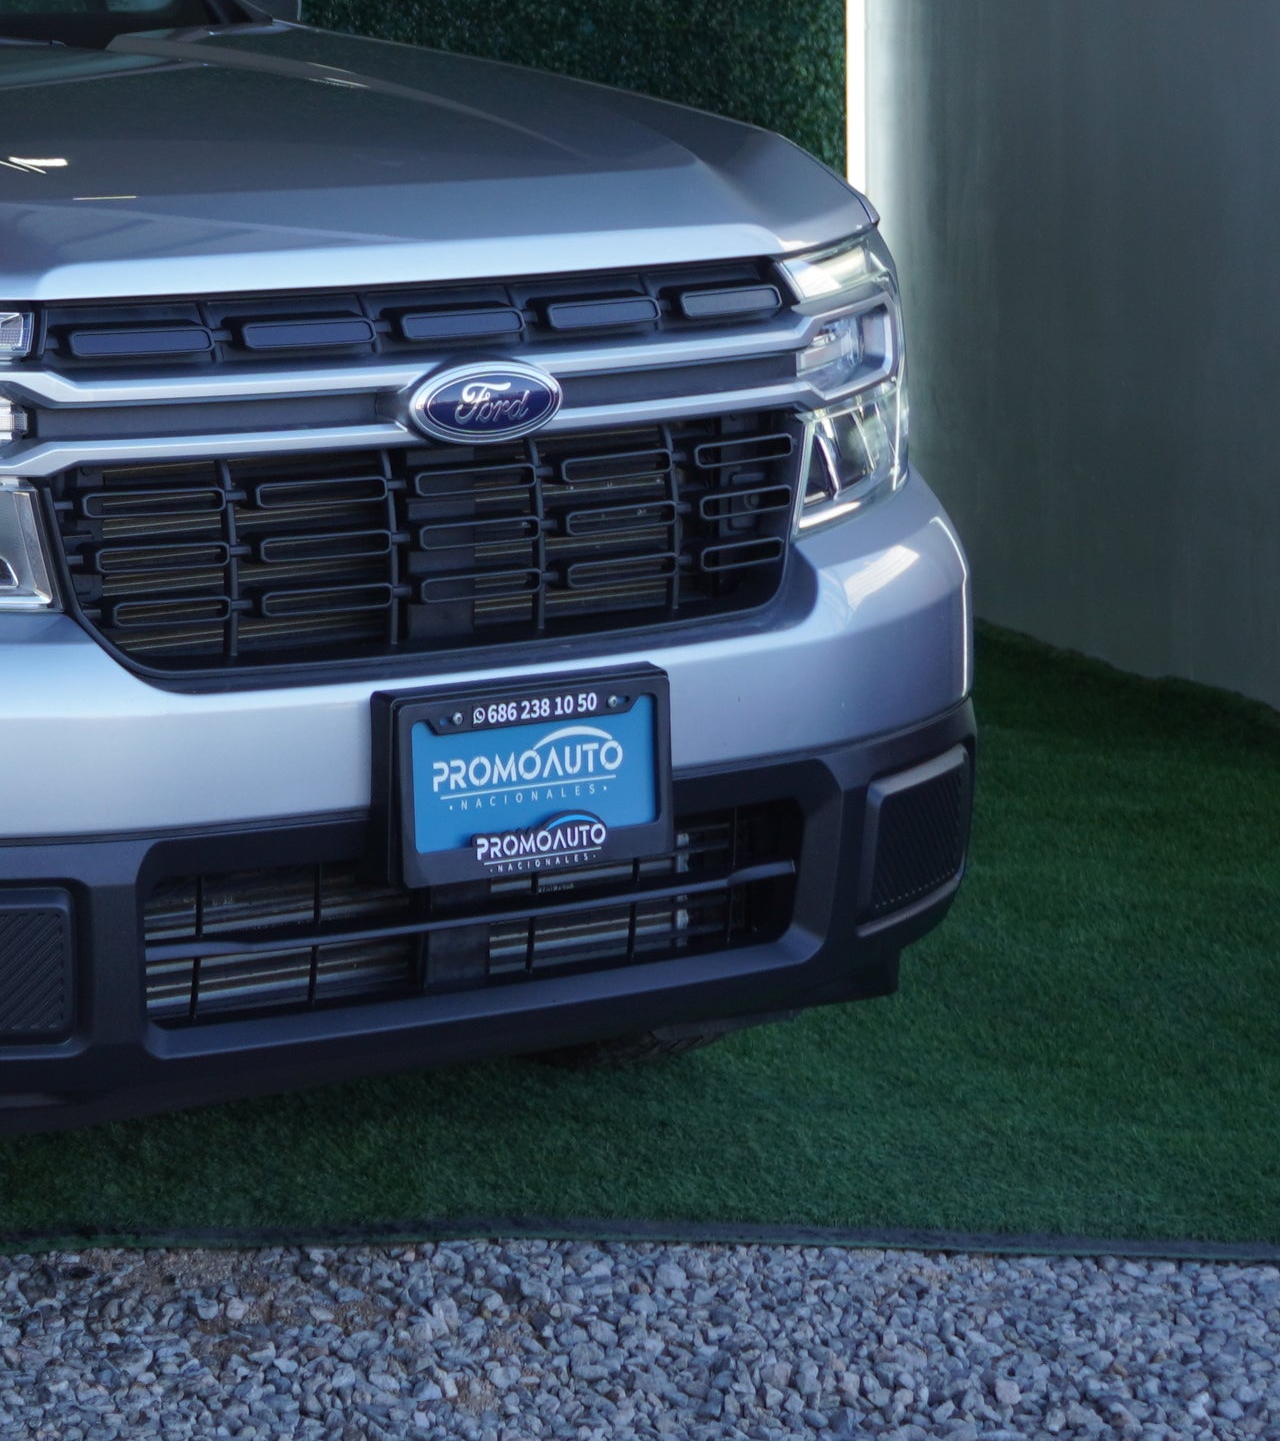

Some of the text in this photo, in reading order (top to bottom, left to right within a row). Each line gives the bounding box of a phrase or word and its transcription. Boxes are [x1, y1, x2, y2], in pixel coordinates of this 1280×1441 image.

[454, 381, 531, 425] Ford
[487, 692, 598, 724] 686 238 10 50
[432, 739, 624, 793] PROMOAUTO
[460, 783, 596, 811] NACIONALES
[476, 823, 607, 861] PROMOAUTO
[498, 852, 589, 873] NACIONALES
